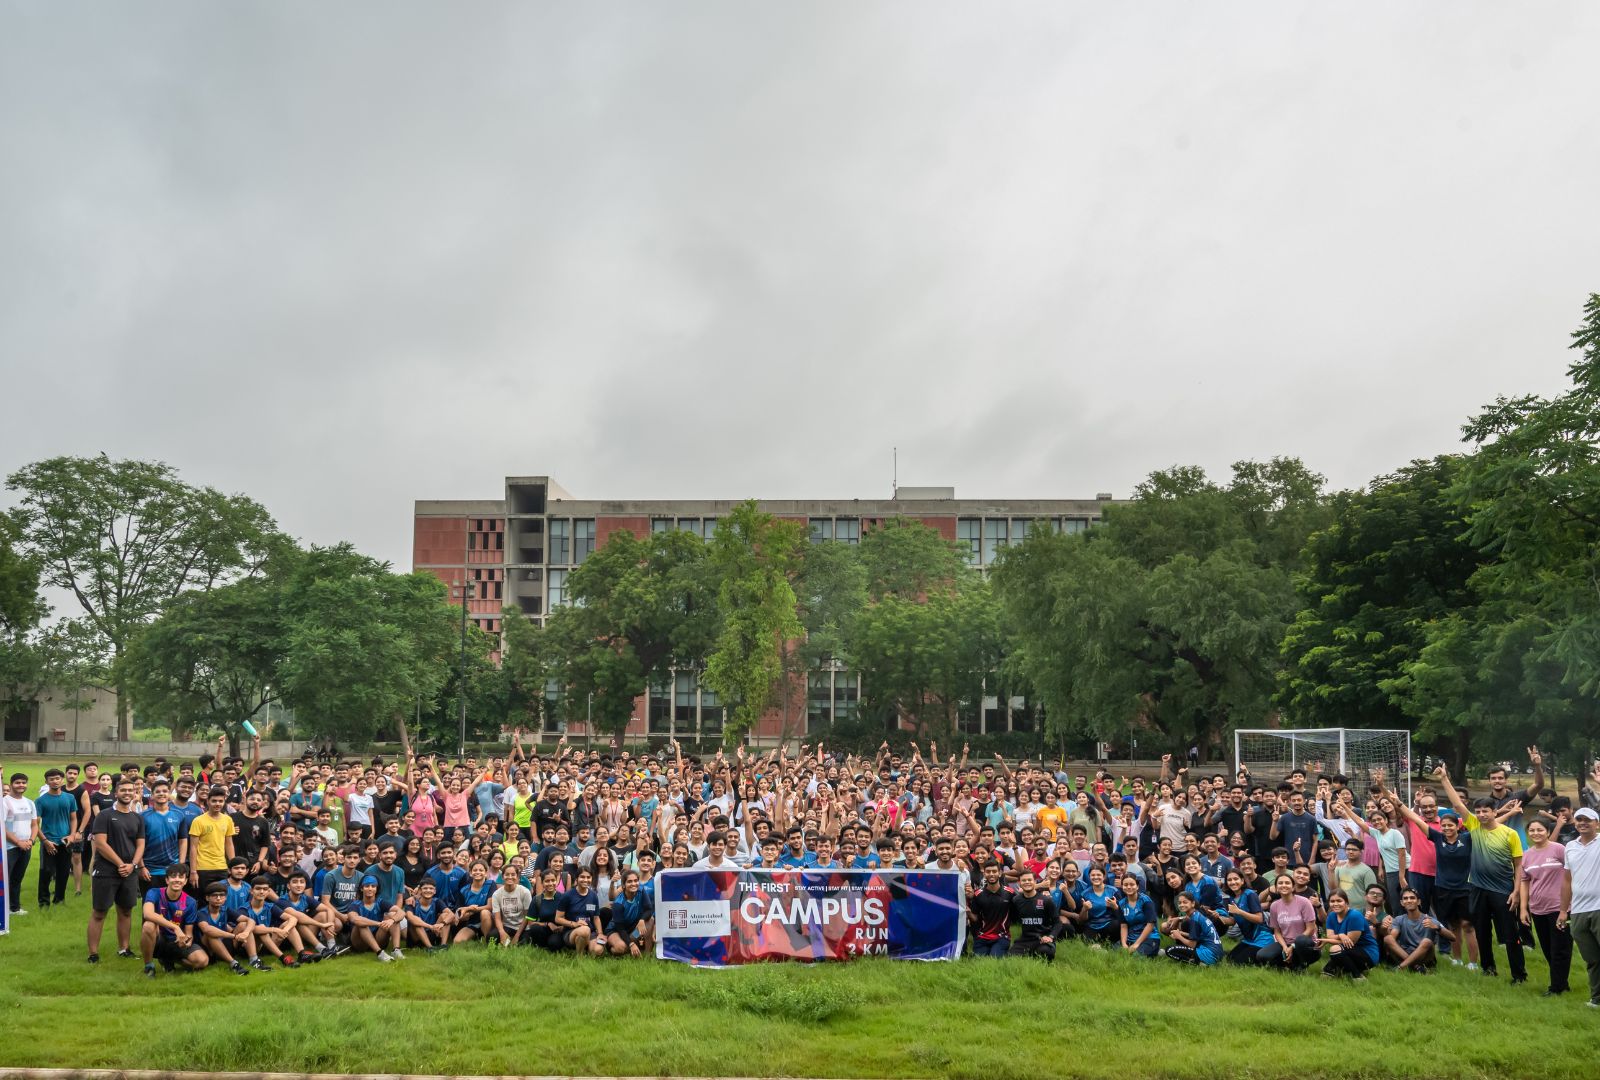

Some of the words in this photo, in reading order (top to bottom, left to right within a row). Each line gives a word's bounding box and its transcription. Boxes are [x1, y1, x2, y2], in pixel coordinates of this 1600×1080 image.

[338, 883, 355, 892] TODAY
[739, 882, 758, 892] THE
[761, 882, 790, 893] FIRST
[740, 897, 885, 925] CAMPUS
[855, 927, 888, 940] RUN
[848, 943, 856, 955] 2
[863, 943, 888, 955] KM
